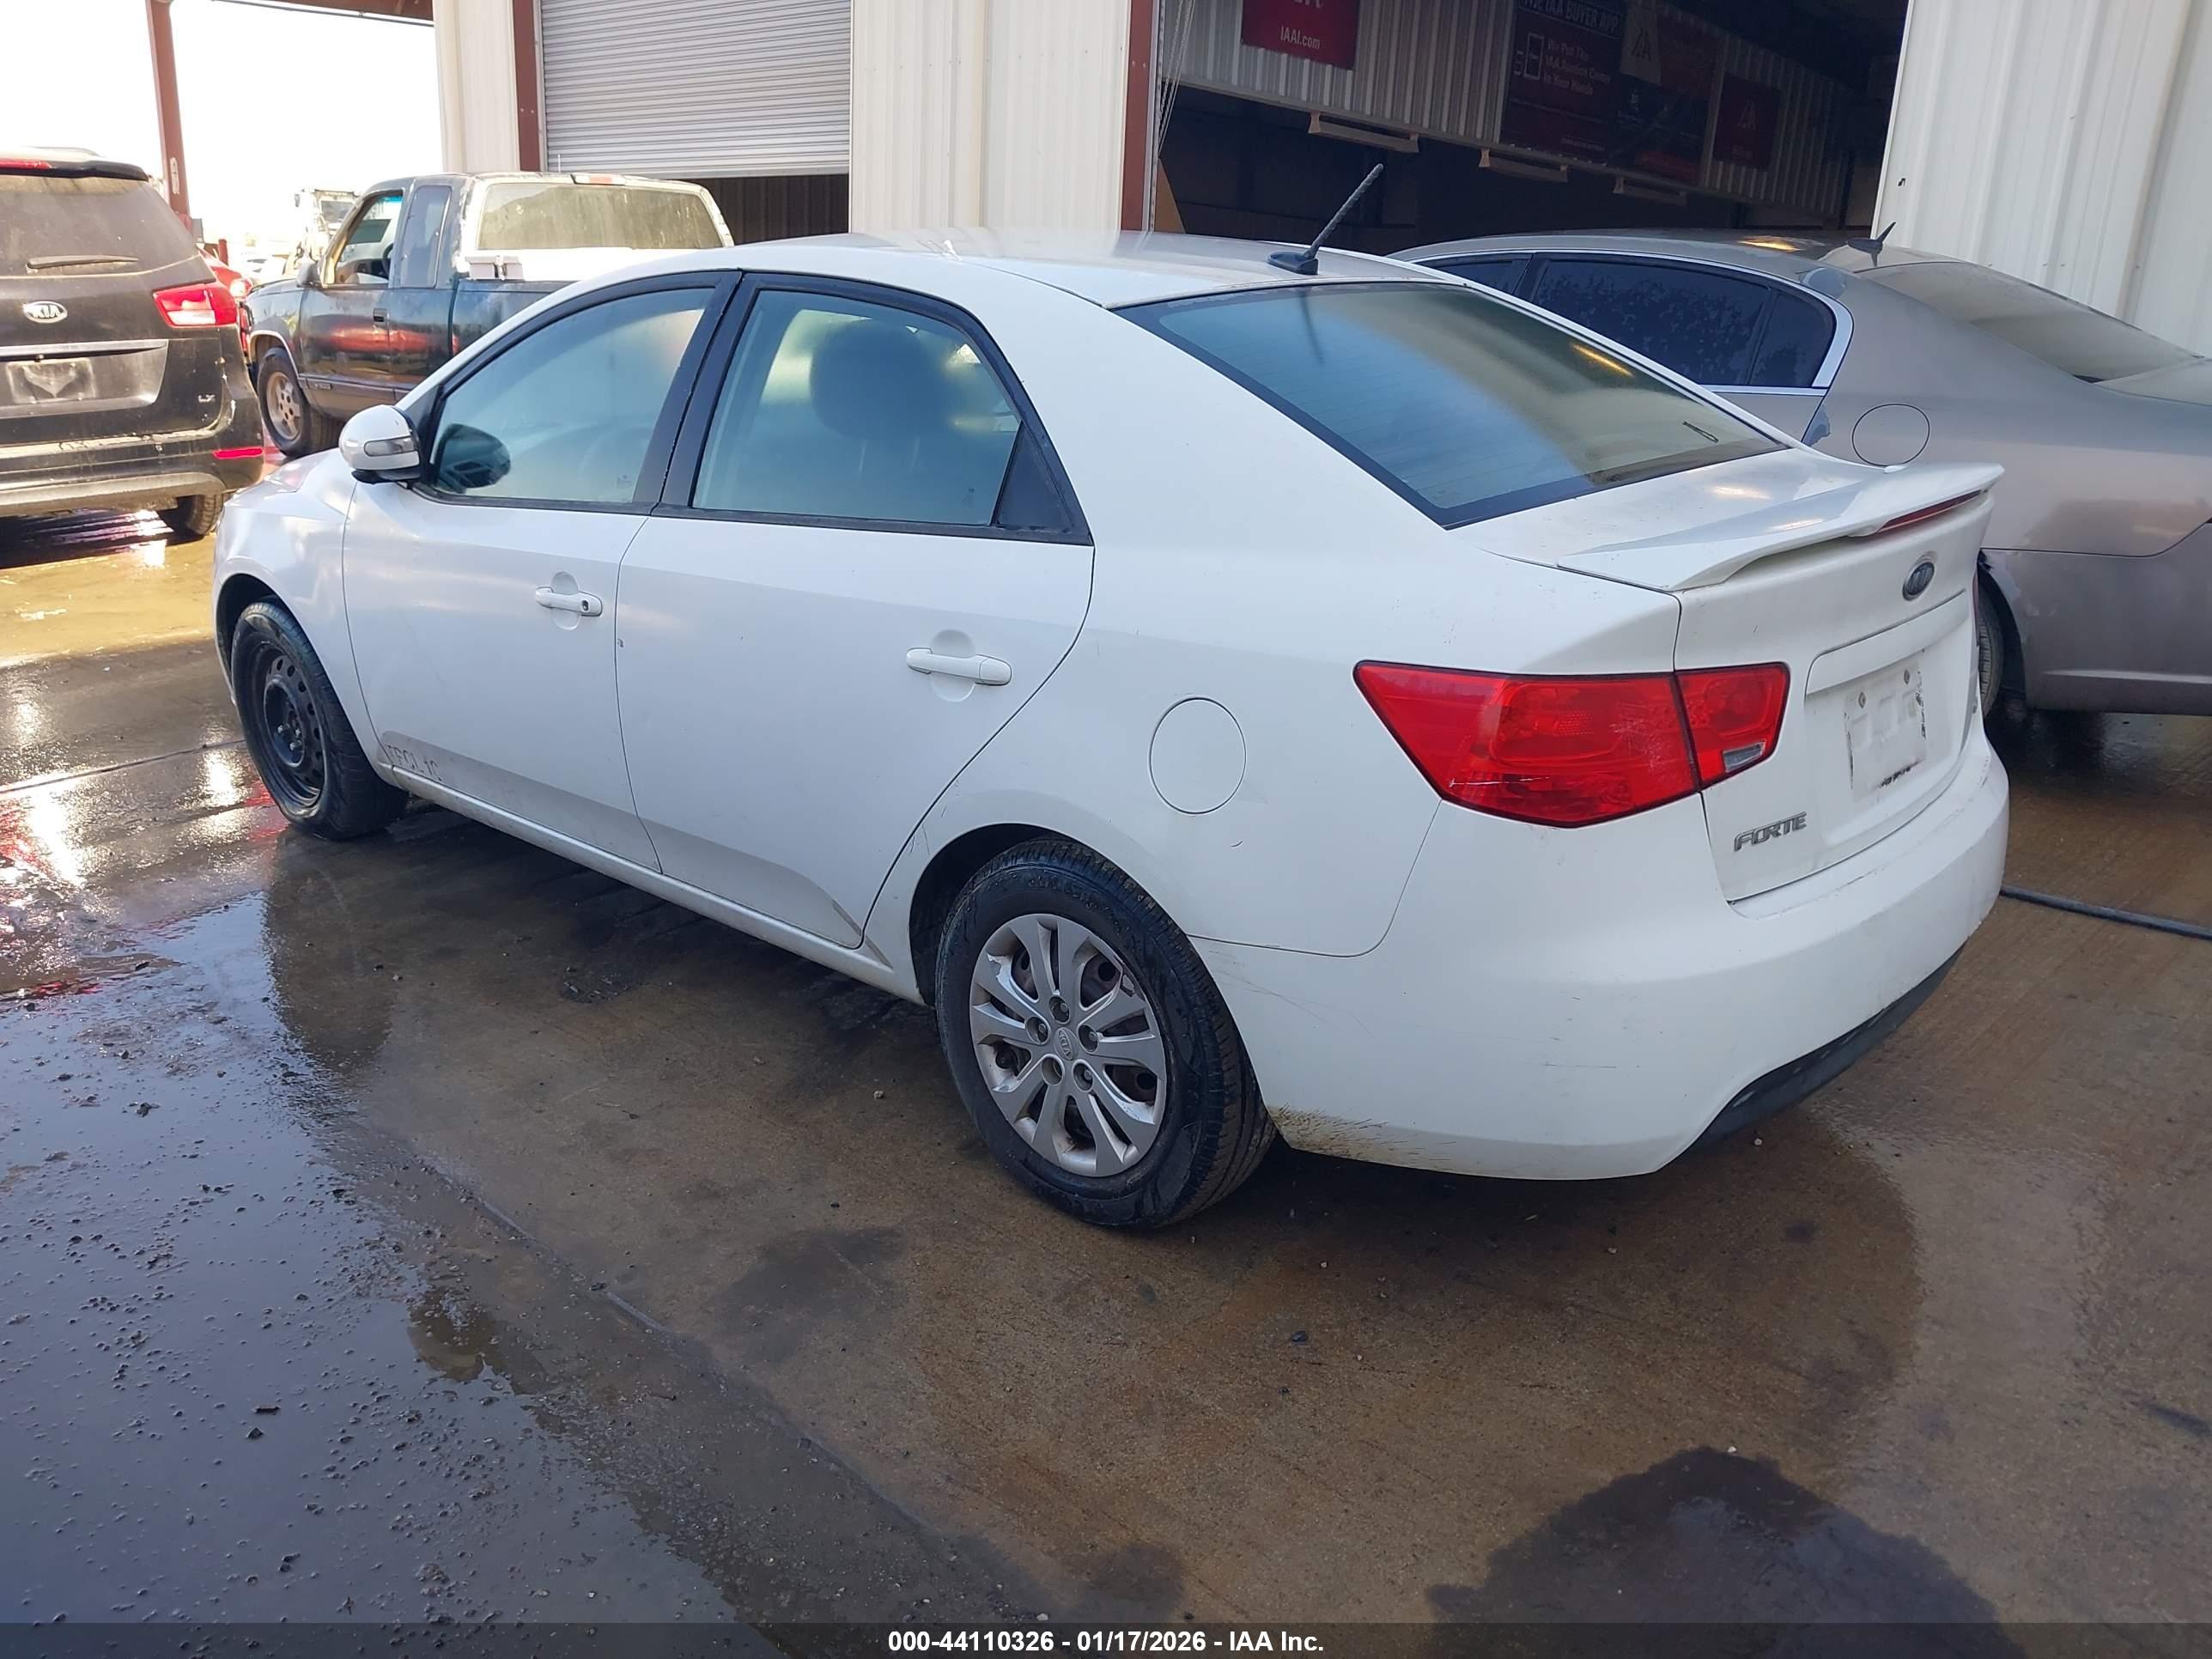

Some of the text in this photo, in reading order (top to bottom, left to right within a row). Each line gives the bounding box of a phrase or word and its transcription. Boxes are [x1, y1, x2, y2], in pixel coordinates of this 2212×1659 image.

[1280, 26, 1321, 50] IAAI.com
[33, 304, 61, 319] KIA
[198, 394, 216, 403] LX
[1734, 811, 1808, 852] FORTE
[1058, 1030, 1073, 1061] KIA
